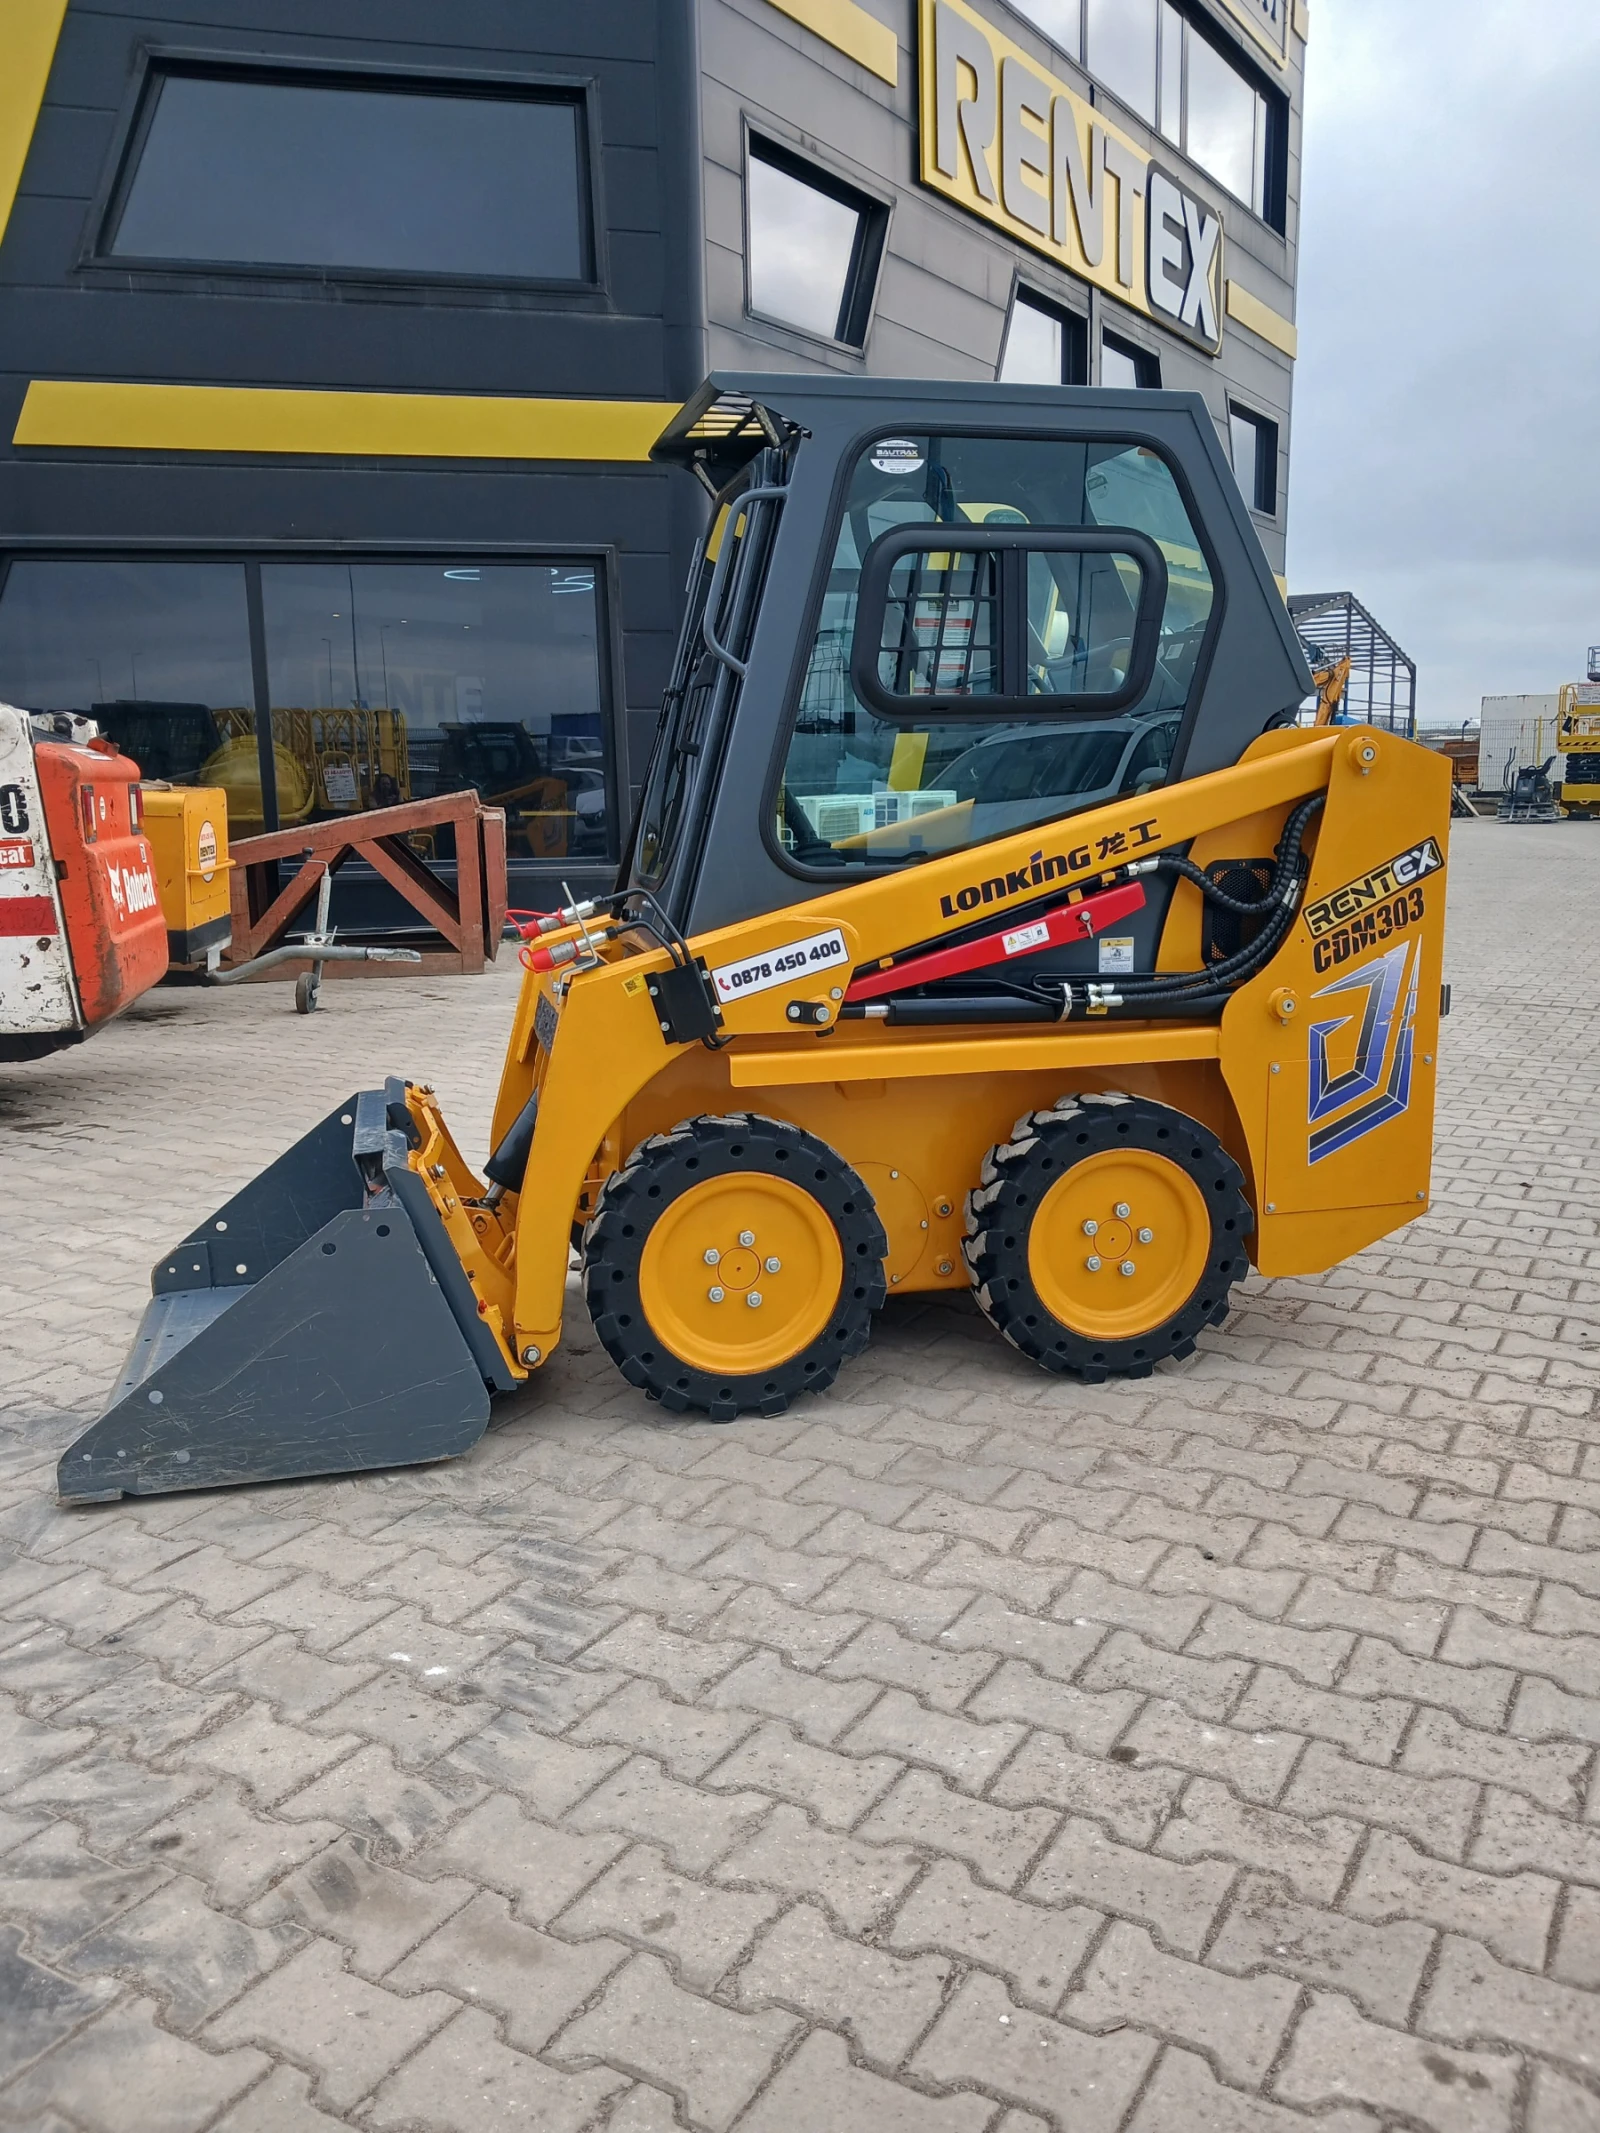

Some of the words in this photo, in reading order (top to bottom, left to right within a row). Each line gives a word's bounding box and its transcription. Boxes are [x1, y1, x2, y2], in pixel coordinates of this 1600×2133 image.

[935, 0, 1220, 342] RENTEX
[122, 865, 157, 914] Bobcat
[1308, 843, 1438, 933] RENTEX
[1313, 887, 1425, 974] CDM303
[731, 963, 772, 988] 0878
[775, 951, 807, 972] 450
[809, 940, 841, 961] 400
